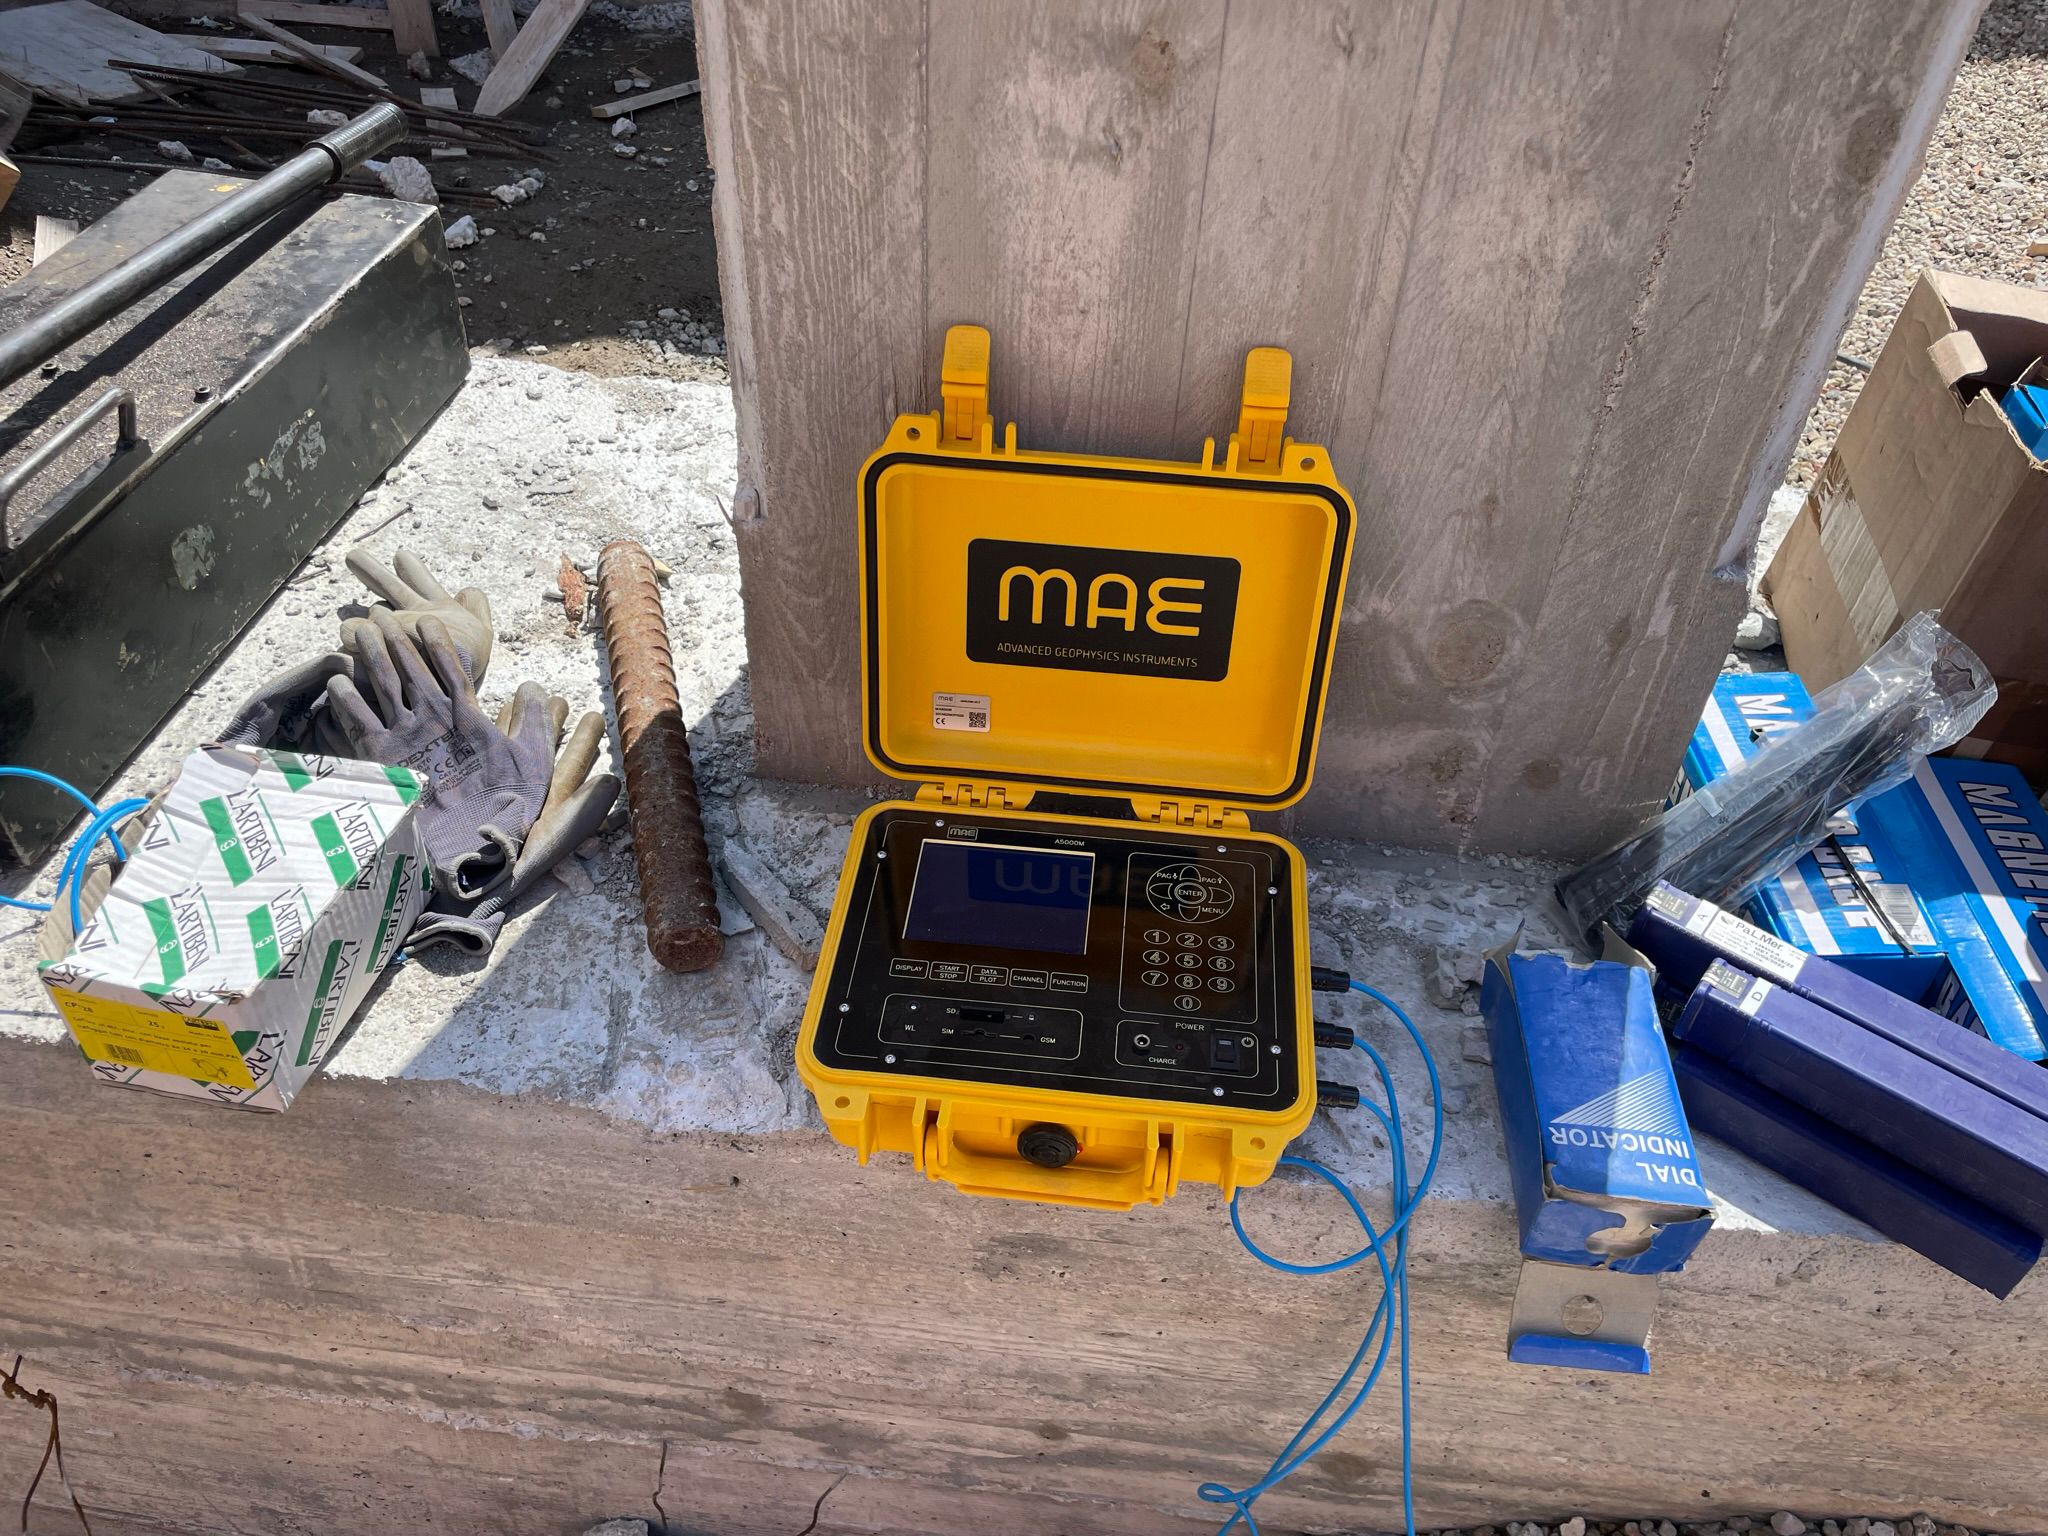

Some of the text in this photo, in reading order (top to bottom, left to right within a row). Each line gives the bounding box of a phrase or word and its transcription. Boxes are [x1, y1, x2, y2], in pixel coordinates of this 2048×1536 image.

[998, 565, 1206, 638] MAE
[997, 642, 1199, 668] ADVANCED GEOPHYSICS INSTRUMENTS
[226, 786, 278, 874] L'ARTIBENI
[1054, 838, 1085, 847] A5000M
[1201, 876, 1217, 884] PAG
[1178, 889, 1203, 897] ENTER
[374, 855, 418, 974] L'ARTIBENI
[1202, 907, 1224, 915] MENU
[170, 884, 211, 973] L'ARTIBENI
[1152, 931, 1228, 950] 1 2 3
[1150, 951, 1227, 970] 4 5 6
[895, 964, 923, 973] DISPLAY
[939, 964, 960, 972] START
[980, 968, 998, 976] DATA
[939, 972, 958, 980] STOP
[979, 976, 997, 984] PLOT
[1013, 974, 1045, 985] CHANNEL
[1052, 978, 1086, 988] FUNCTION
[1149, 972, 1228, 991] 7 8 9
[308, 938, 361, 1067] L'ARTIBENI
[946, 1007, 957, 1015] SD
[904, 1024, 916, 1032] WL
[941, 1027, 954, 1036] SIM
[1175, 1022, 1205, 1032] POWER
[1040, 1036, 1056, 1044] GSM
[1148, 1056, 1178, 1066] CHARGE
[1548, 1126, 1690, 1159] INDICATOR
[1636, 1161, 1697, 1187] DIAL
